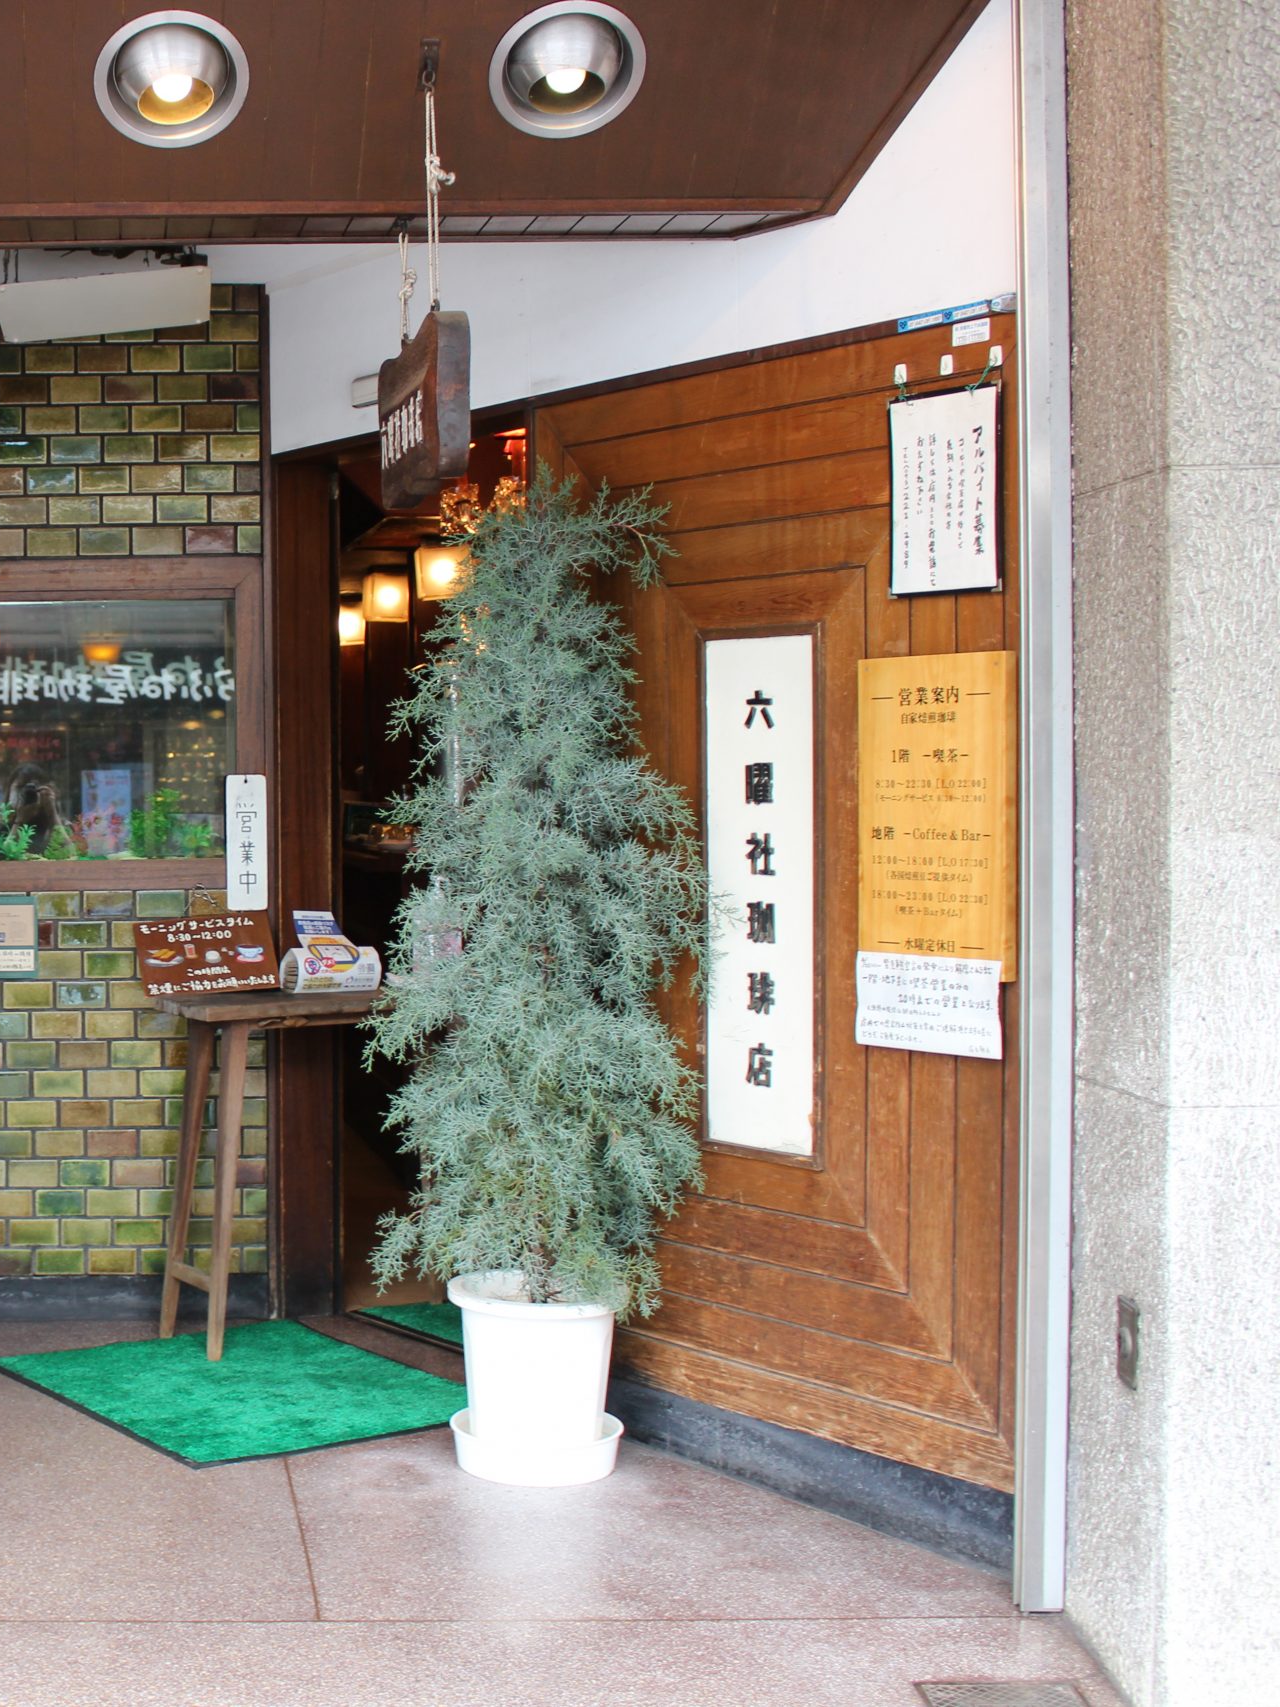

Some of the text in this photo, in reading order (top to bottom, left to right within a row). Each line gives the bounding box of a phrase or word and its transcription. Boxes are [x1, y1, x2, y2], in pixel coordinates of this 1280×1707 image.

[898, 685, 960, 707] 営業案内
[871, 826, 895, 841] 地階
[235, 796, 257, 894] 営業中
[744, 690, 776, 1088] 六曜社珈琲店
[904, 937, 956, 953] 水曜定休日
